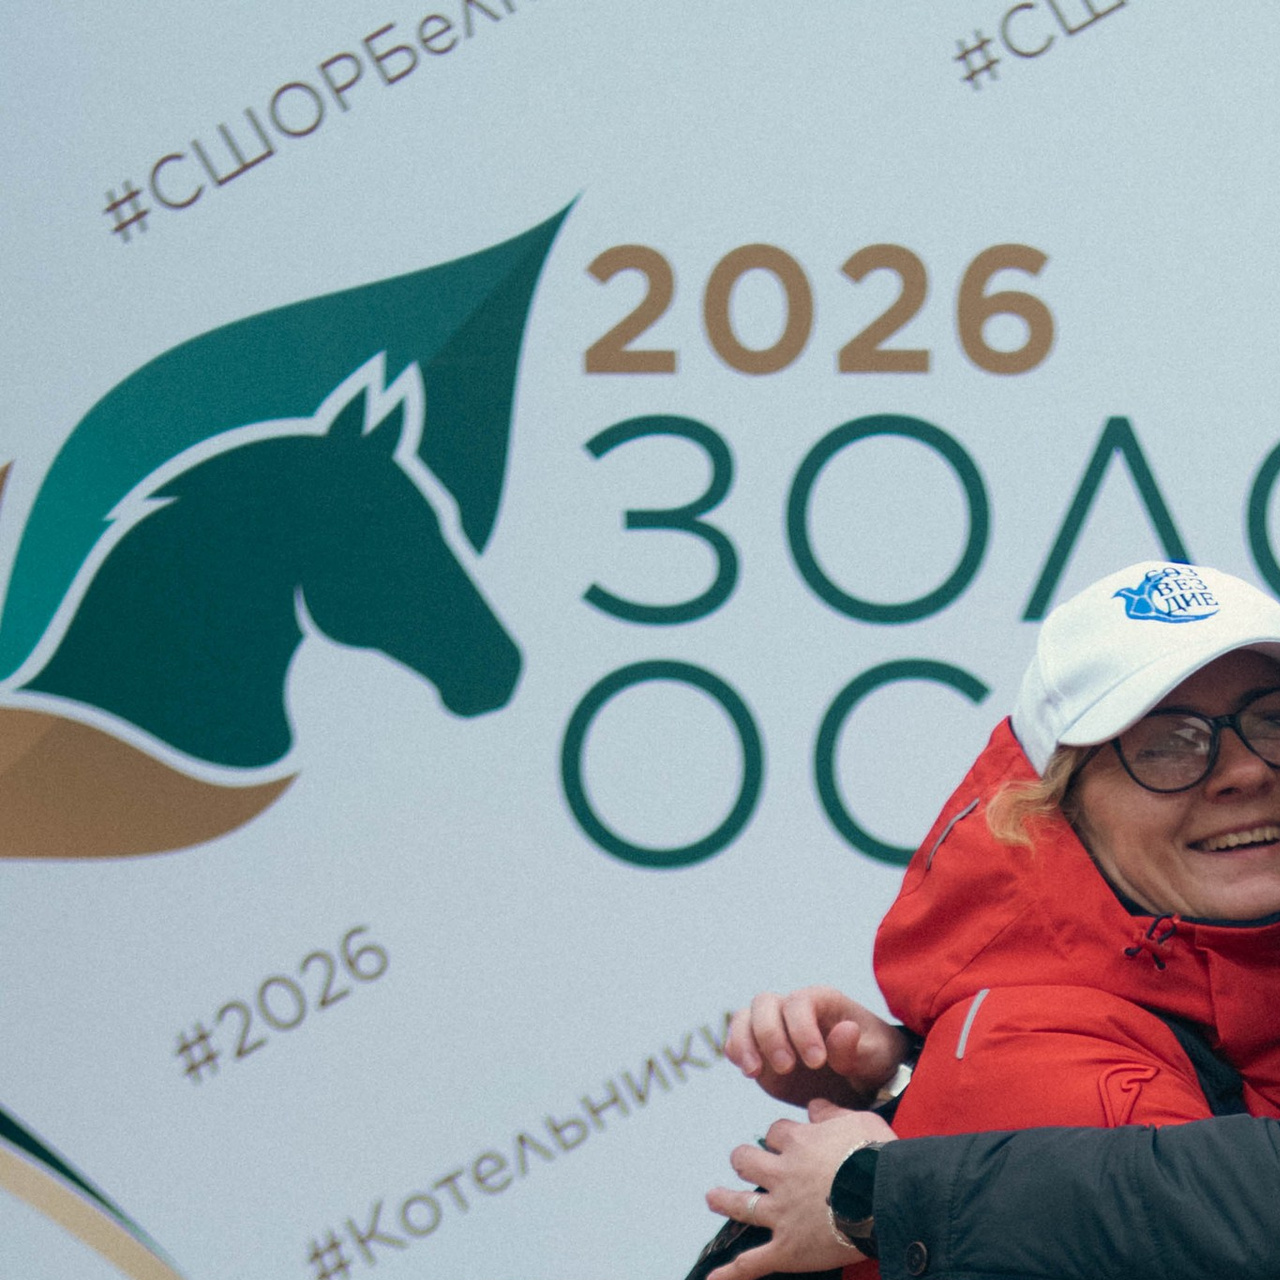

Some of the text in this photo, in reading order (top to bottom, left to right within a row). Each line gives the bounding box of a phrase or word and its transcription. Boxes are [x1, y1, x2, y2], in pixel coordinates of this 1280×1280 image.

[103, 0, 518, 242] #СШОРБел
[584, 243, 1056, 376] 2026
[1156, 578, 1208, 597] ВЕЗ
[1163, 592, 1219, 616] ДИЕ
[175, 926, 389, 1082] #2026
